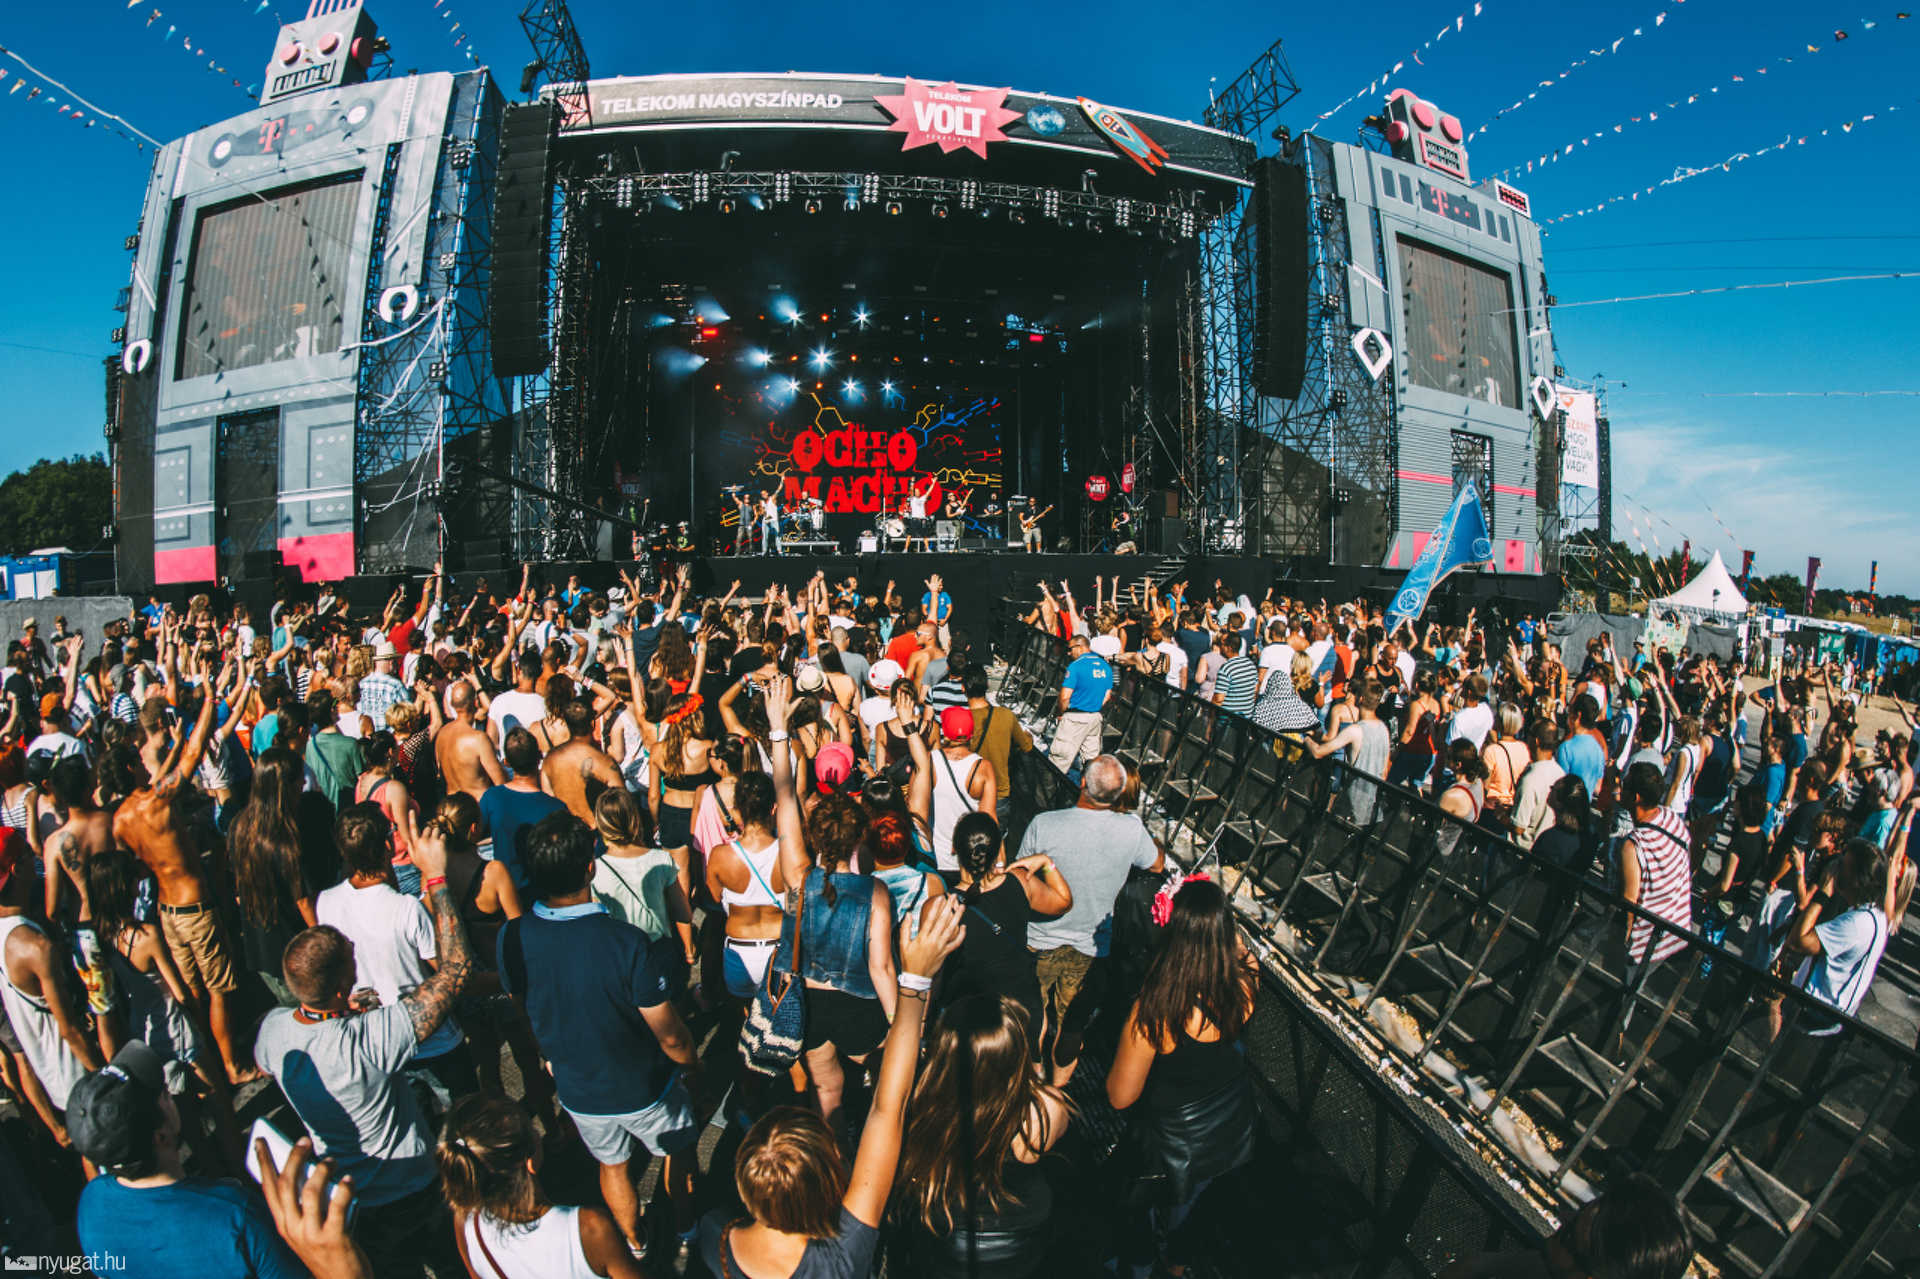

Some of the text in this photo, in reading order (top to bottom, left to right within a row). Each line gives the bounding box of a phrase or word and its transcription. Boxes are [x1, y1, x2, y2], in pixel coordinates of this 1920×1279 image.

[601, 90, 843, 114] TELEKOM NAGYSZÍNPAD
[913, 100, 986, 138] VOLT
[793, 424, 917, 472] OCHO
[784, 468, 943, 516] MACHO
